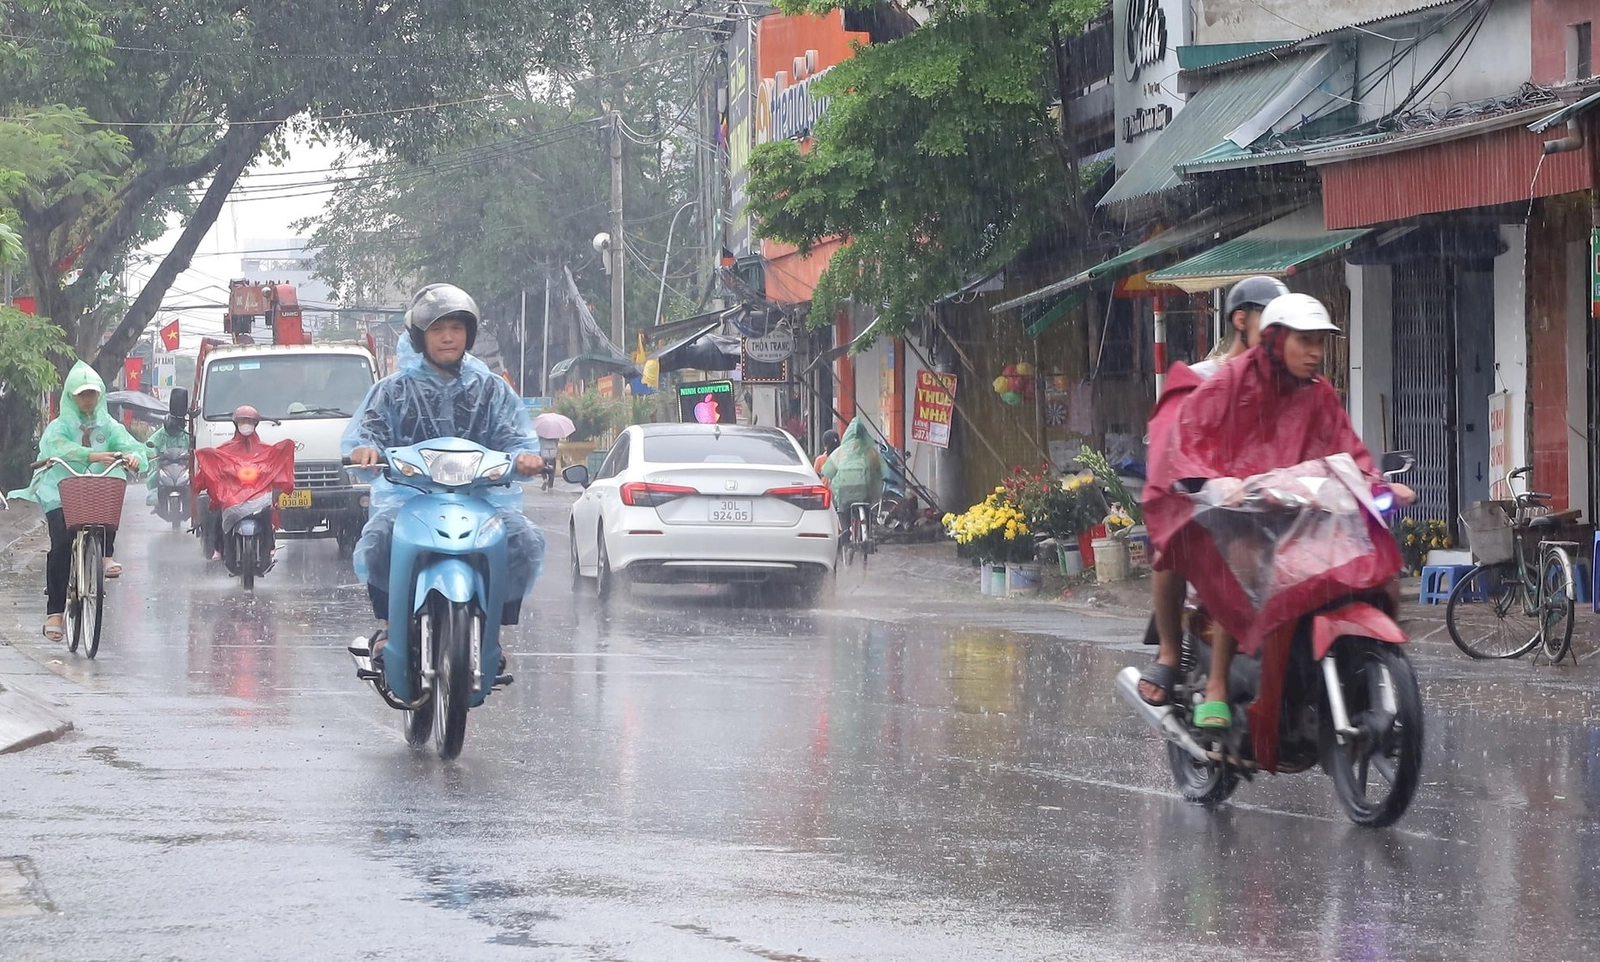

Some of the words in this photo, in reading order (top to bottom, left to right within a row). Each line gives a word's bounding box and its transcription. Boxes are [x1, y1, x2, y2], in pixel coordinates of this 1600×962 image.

[697, 384, 730, 394] COMPUTER
[920, 405, 948, 424] NHÀ
[721, 501, 740, 511] 30L
[713, 511, 748, 521] 924.05
